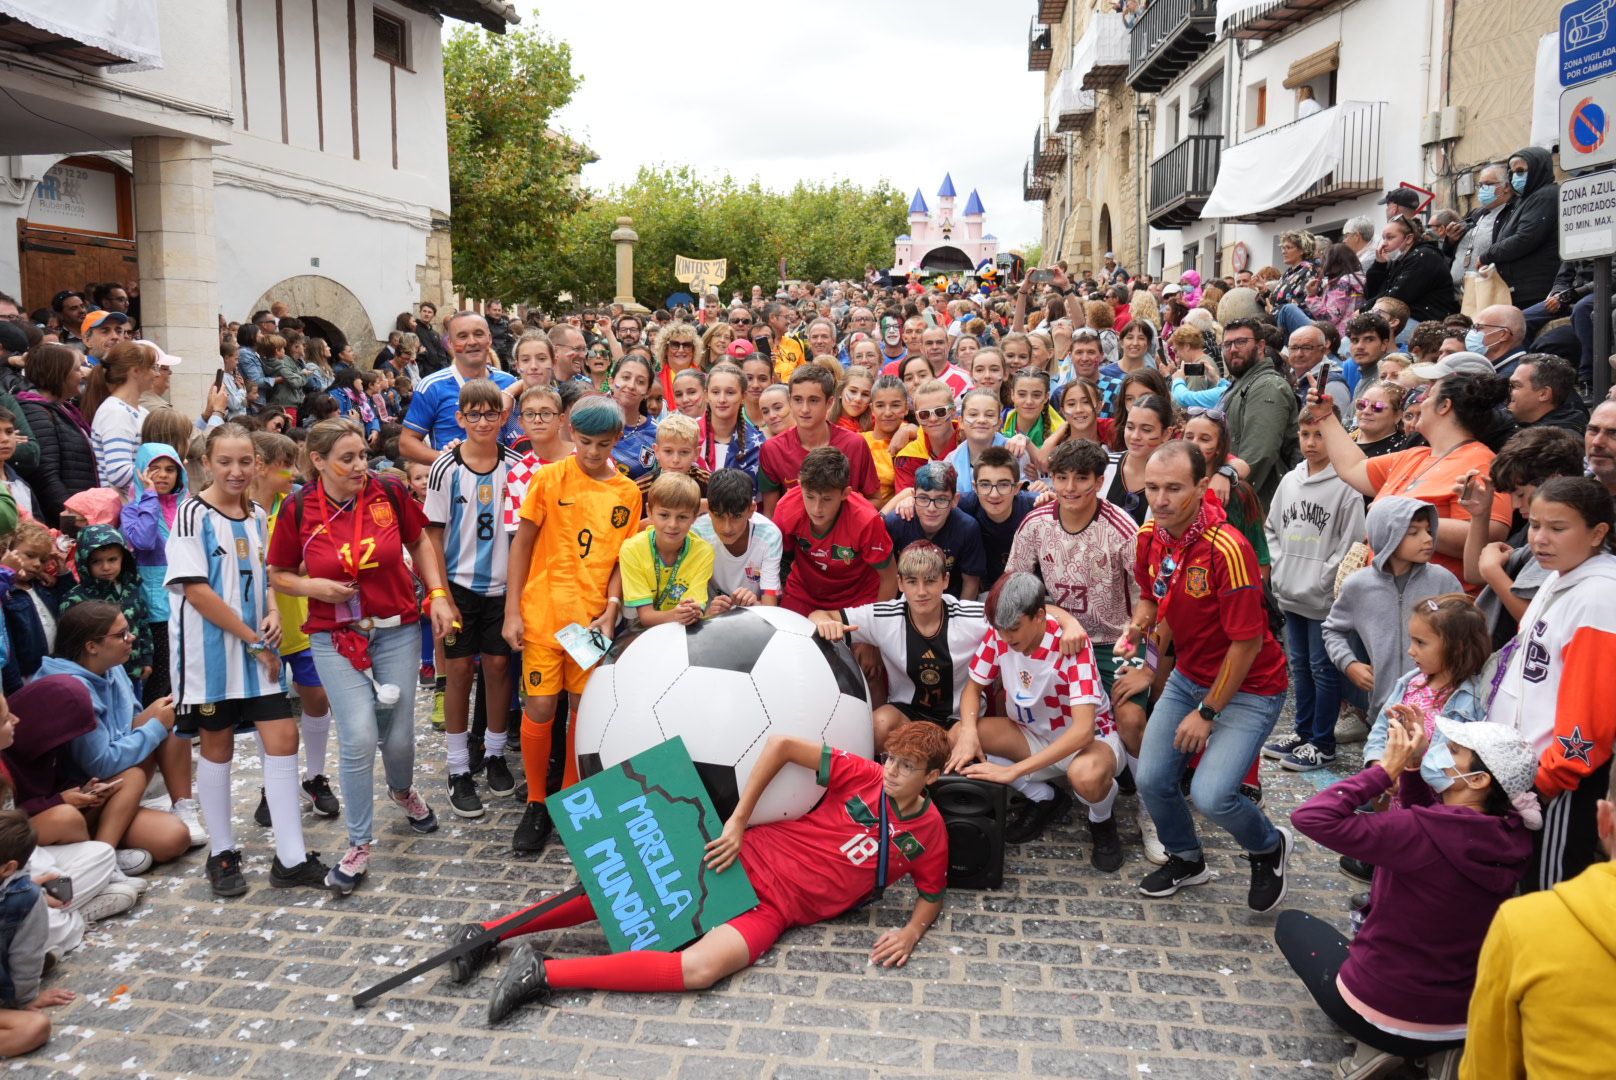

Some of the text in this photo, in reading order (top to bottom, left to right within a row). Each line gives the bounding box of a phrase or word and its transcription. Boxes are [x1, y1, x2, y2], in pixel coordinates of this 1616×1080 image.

[1563, 46, 1616, 70] ZONA VIGILADA
[1566, 69, 1581, 80] POR
[1562, 180, 1616, 202] ZONA AZUL
[1562, 197, 1616, 218] AUTORIZADOS
[1564, 215, 1614, 232] 30 MIN. MAX.
[675, 256, 710, 277] KINTOS
[477, 512, 494, 541] 8
[577, 528, 593, 559] 9
[240, 569, 253, 602] 7
[1055, 583, 1088, 614] 23
[1014, 703, 1036, 724] 11
[561, 786, 603, 832] DE
[617, 794, 693, 921] MORELLA
[839, 833, 879, 866] 18
